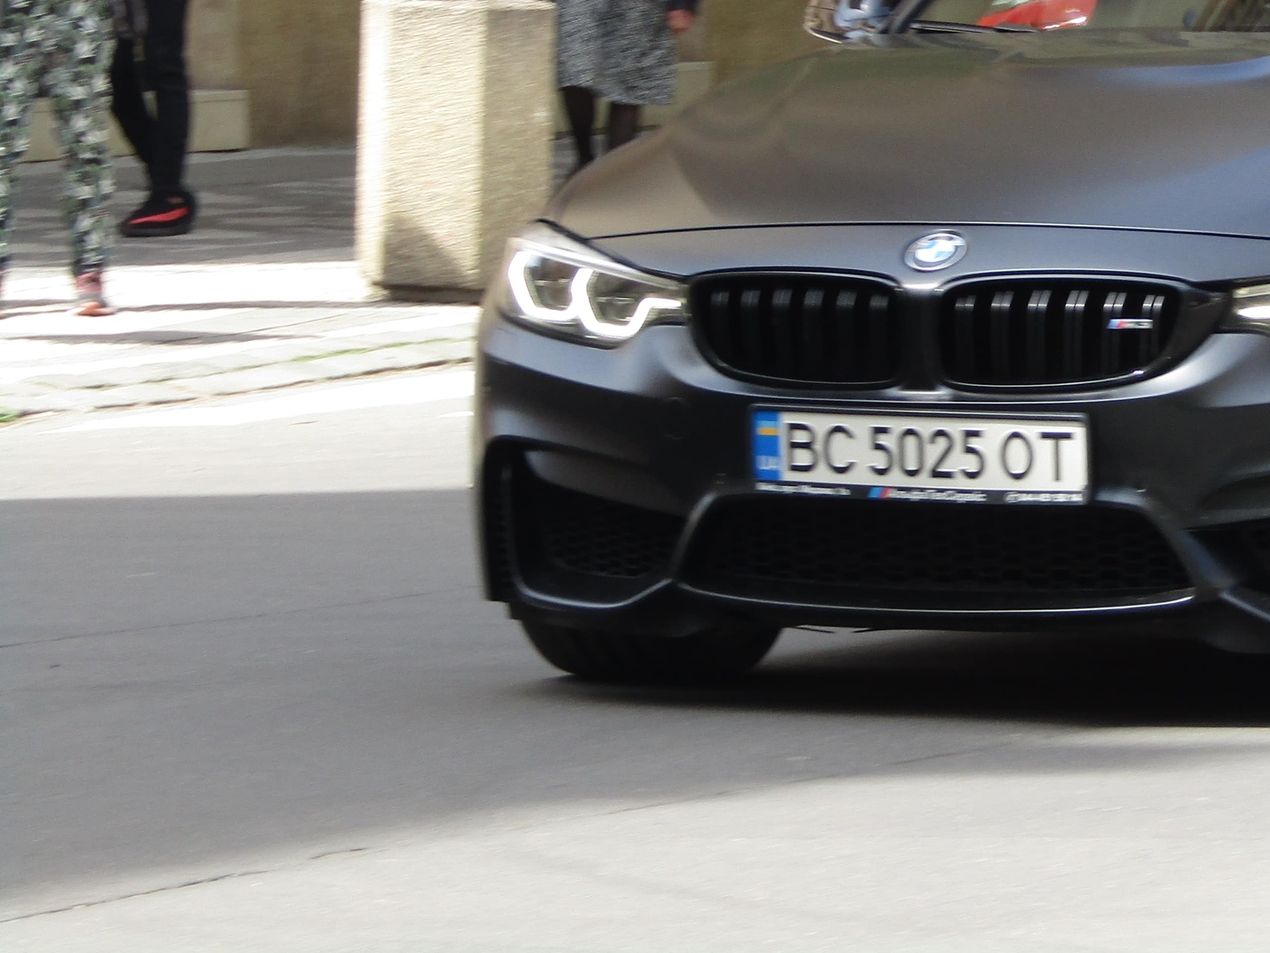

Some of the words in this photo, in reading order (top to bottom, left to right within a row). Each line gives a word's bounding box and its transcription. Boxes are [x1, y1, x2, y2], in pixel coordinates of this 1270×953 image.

[786, 422, 856, 475] BC
[868, 425, 986, 479] 5025
[1001, 431, 1076, 481] OT
